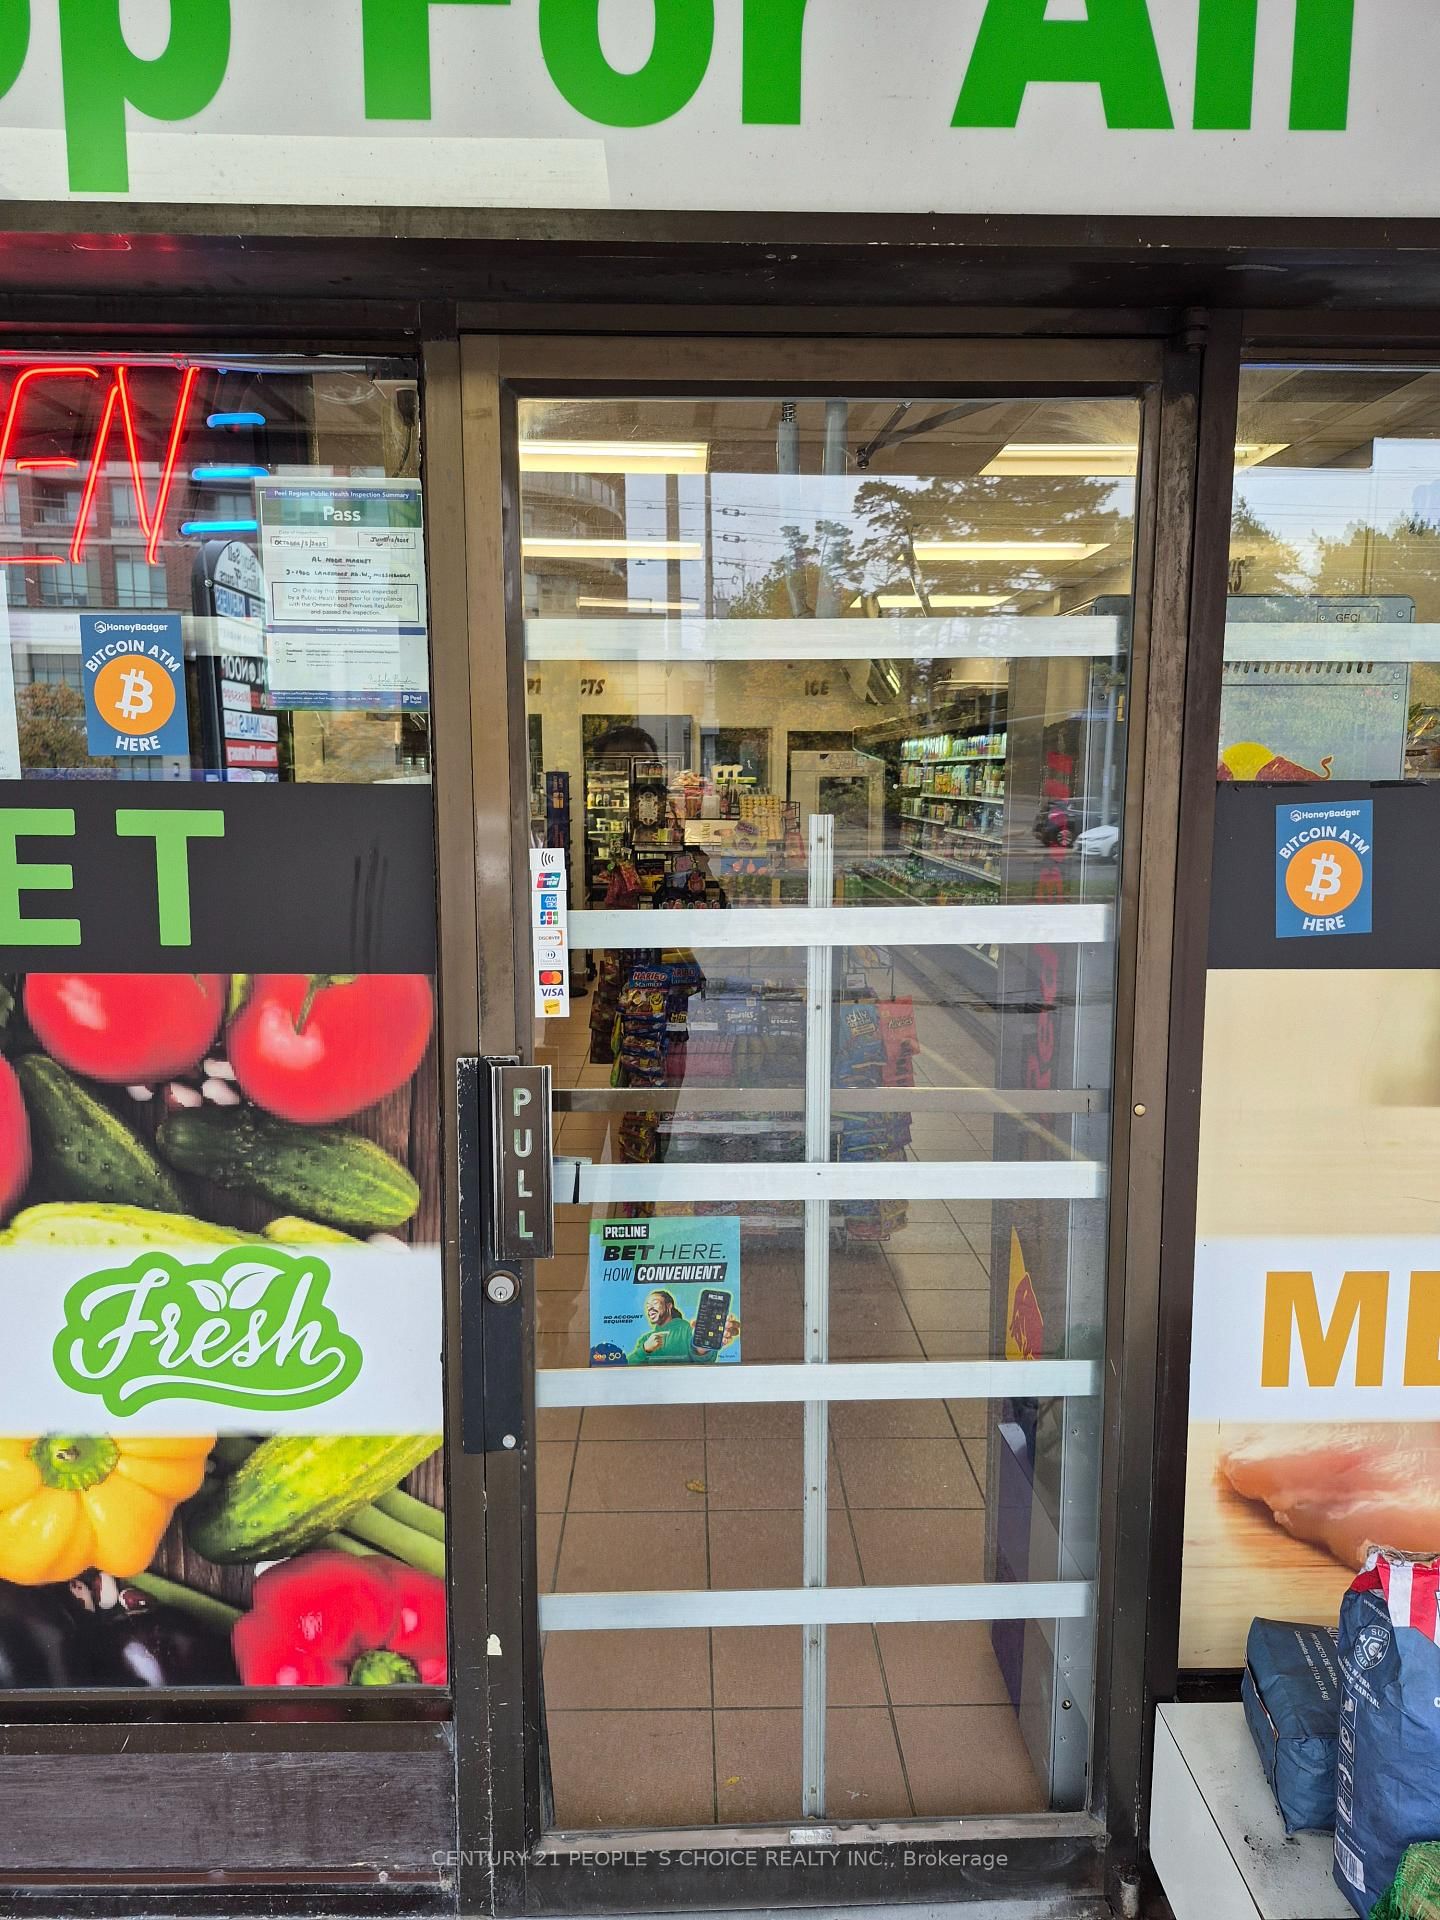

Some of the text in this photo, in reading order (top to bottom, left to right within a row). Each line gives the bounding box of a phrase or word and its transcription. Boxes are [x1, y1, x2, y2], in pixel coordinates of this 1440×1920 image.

[288, 490, 309, 498] Region
[323, 506, 361, 521] Pass
[311, 555, 321, 563] AL
[107, 623, 168, 633] HoneyBadger
[85, 640, 180, 672] BITCOIN ATM
[804, 680, 829, 696] ICE
[115, 735, 161, 752] HERE
[1302, 809, 1360, 820] HoneyBadger
[1279, 826, 1370, 859] BITCOIN ATM
[1302, 914, 1345, 931] HERE
[632, 971, 668, 981] HARIBO
[541, 988, 564, 997] VISA
[513, 1087, 534, 1238] PULL
[604, 1225, 647, 1239] PROLINE
[603, 1243, 726, 1261] BET HERE.
[603, 1265, 724, 1281] HOW CONVENIENT.
[70, 1268, 346, 1400] Fresh
